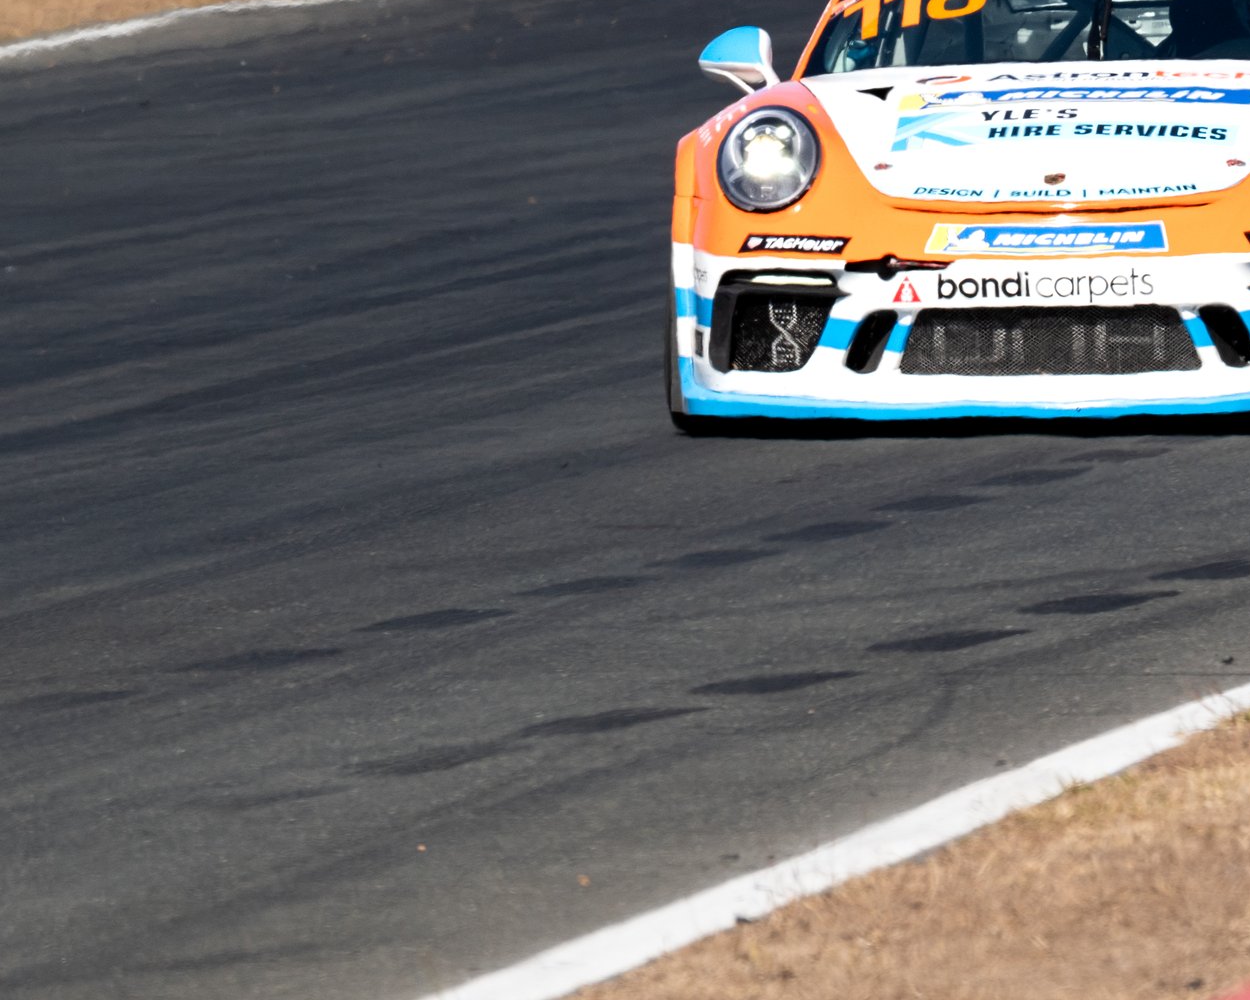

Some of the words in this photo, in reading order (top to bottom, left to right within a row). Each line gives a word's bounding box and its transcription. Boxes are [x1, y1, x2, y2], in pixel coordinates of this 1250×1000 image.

[998, 90, 1226, 100] MICHELIN
[988, 124, 1062, 138] HIRE
[1074, 124, 1228, 140] SERVICES
[913, 187, 982, 197] DESIGN
[1010, 189, 1071, 197] BUILD
[1099, 184, 1197, 196] MAINTAIN
[993, 230, 1146, 246] MICHELIN
